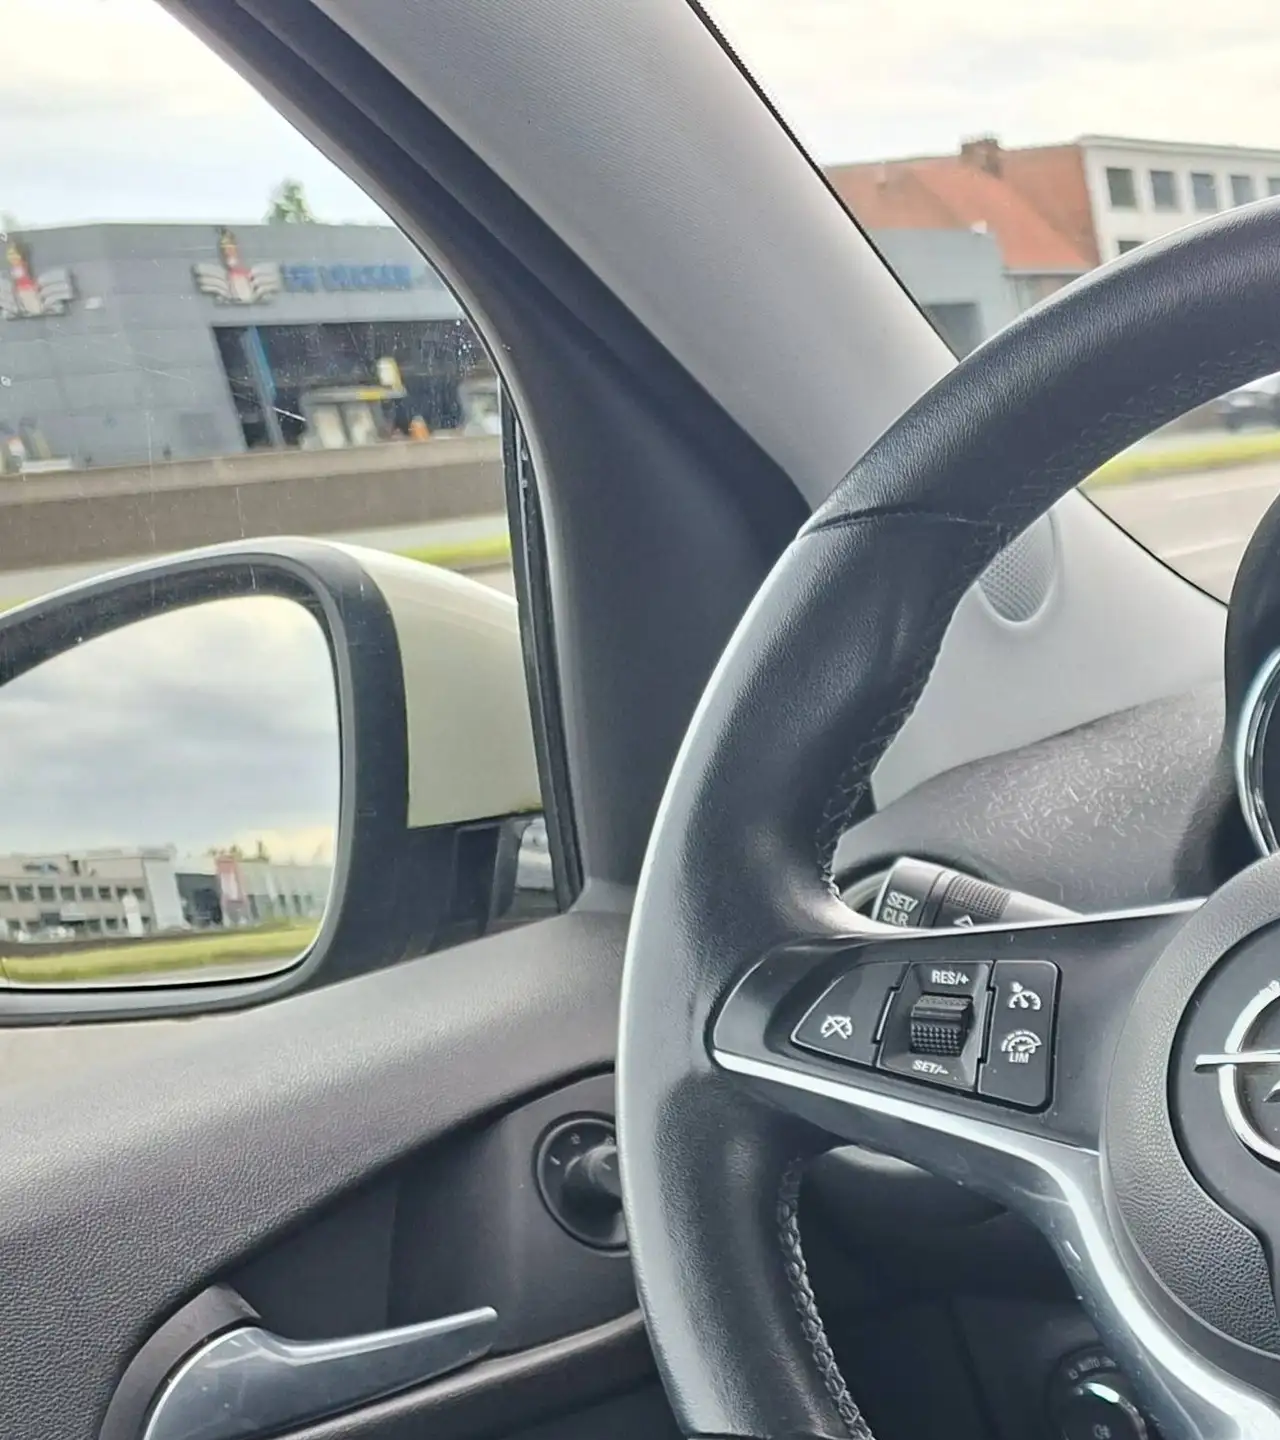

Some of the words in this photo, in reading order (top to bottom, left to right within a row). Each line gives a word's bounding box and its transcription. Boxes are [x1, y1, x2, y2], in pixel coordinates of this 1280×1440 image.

[886, 891, 918, 912] SET/
[882, 909, 909, 928] CLR
[1009, 1052, 1029, 1064] LIM
